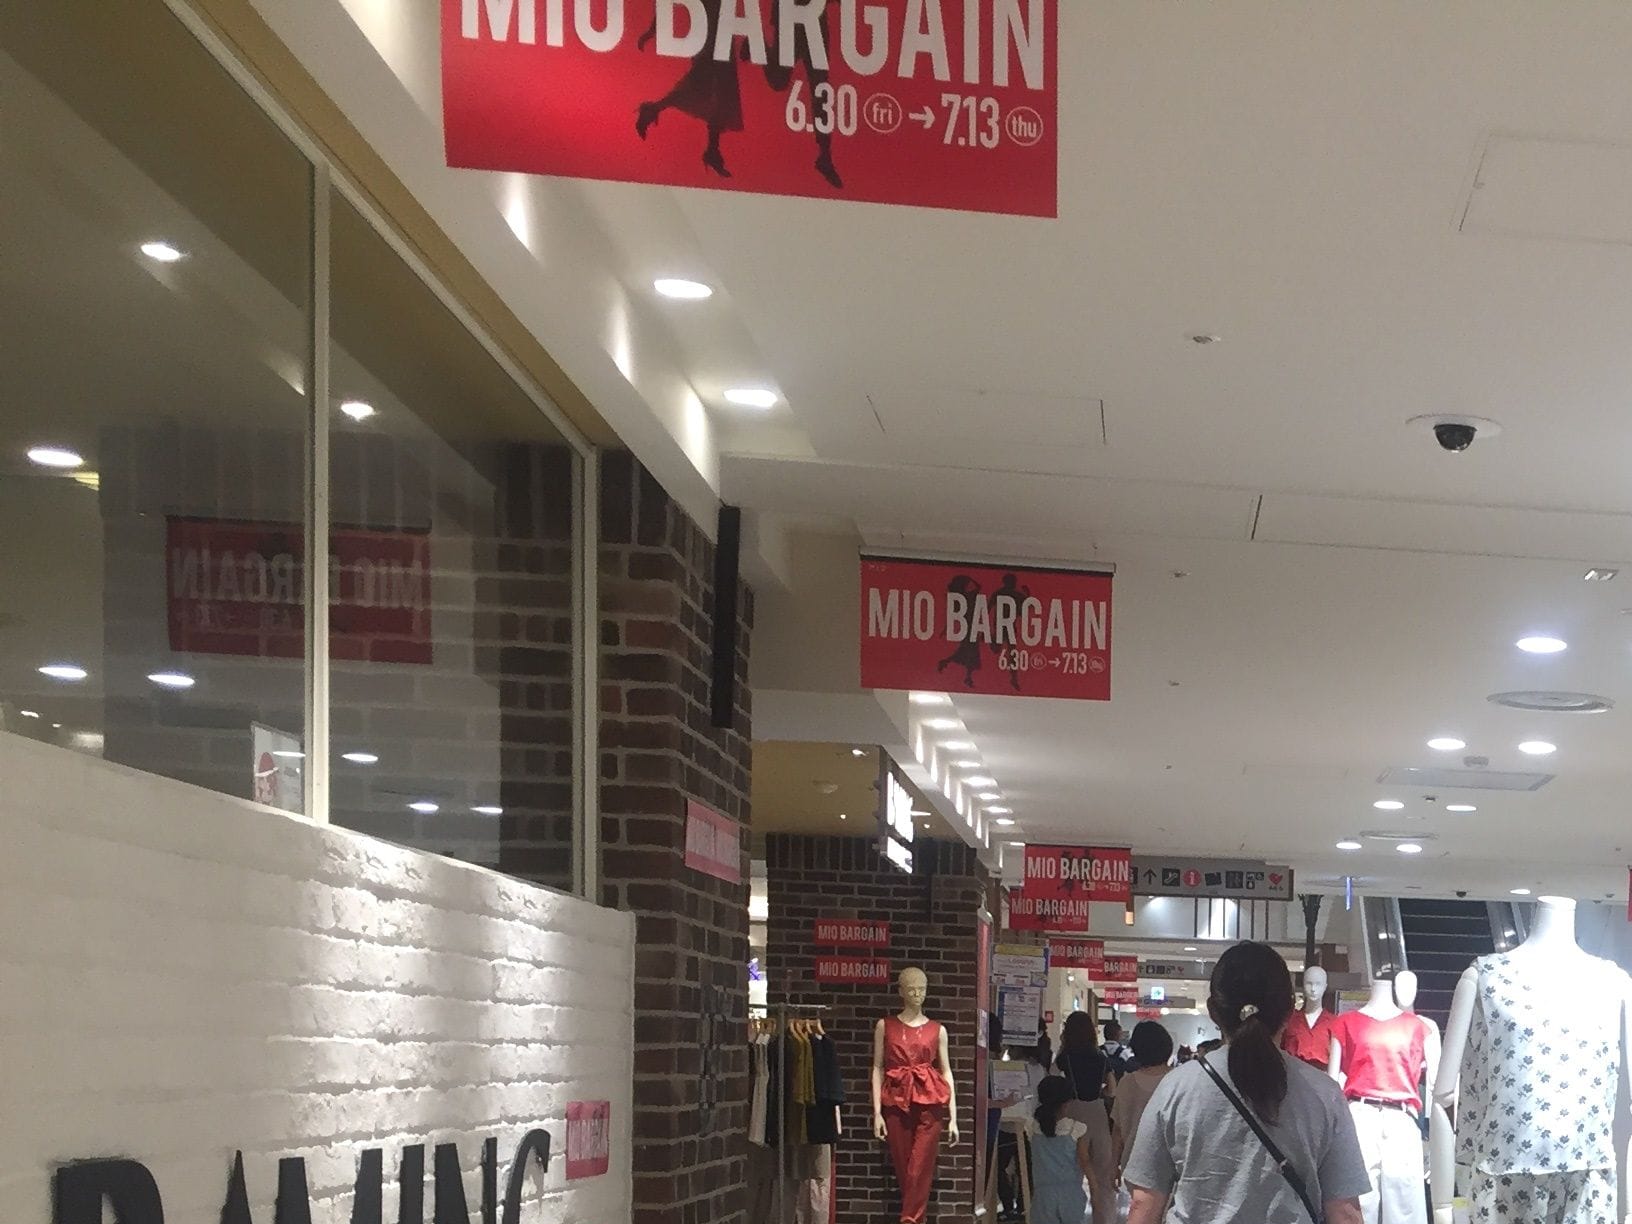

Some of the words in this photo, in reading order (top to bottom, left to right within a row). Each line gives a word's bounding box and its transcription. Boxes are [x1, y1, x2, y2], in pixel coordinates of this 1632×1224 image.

[785, 80, 857, 136] 6.30
[870, 104, 894, 127] fri
[940, 93, 999, 149] 7.13
[1010, 115, 1037, 140] thu
[868, 587, 935, 641] MIO
[946, 592, 1106, 650] BARGAIN
[998, 648, 1029, 671] 6.30
[1062, 652, 1087, 674] 7.13
[1026, 856, 1057, 880] MIO
[1060, 857, 1129, 882] BARGAIN
[1011, 898, 1033, 915] MIO
[1035, 899, 1088, 917] BARGAIN
[818, 925, 838, 940] MIO
[840, 926, 887, 942] BARGAIN
[819, 962, 839, 977] MIO
[841, 962, 887, 978] BARGAIN
